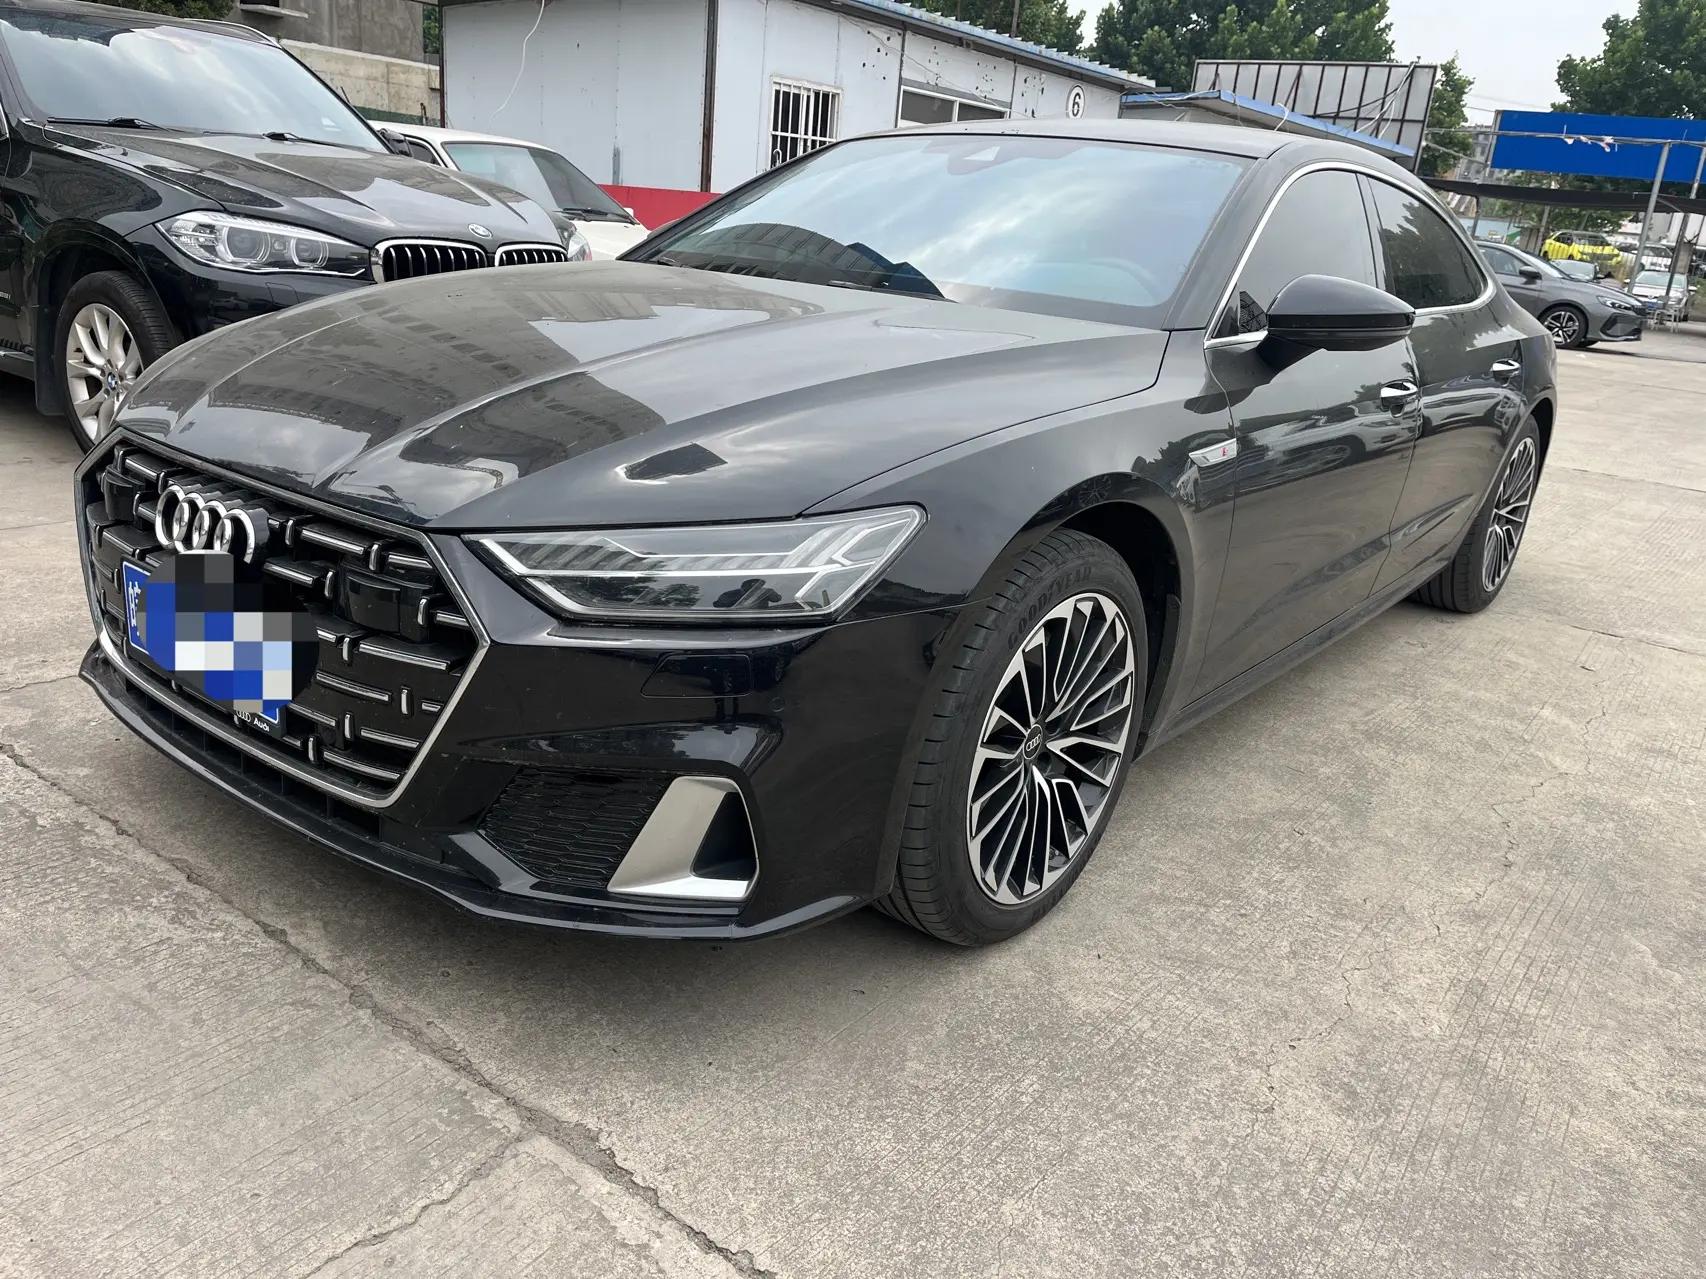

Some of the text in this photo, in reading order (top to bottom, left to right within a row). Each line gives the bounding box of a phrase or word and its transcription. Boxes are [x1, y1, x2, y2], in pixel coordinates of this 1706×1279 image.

[1072, 92, 1081, 117] 6
[1008, 567, 1091, 649] GOODYEAR
[253, 717, 270, 732] Audi
